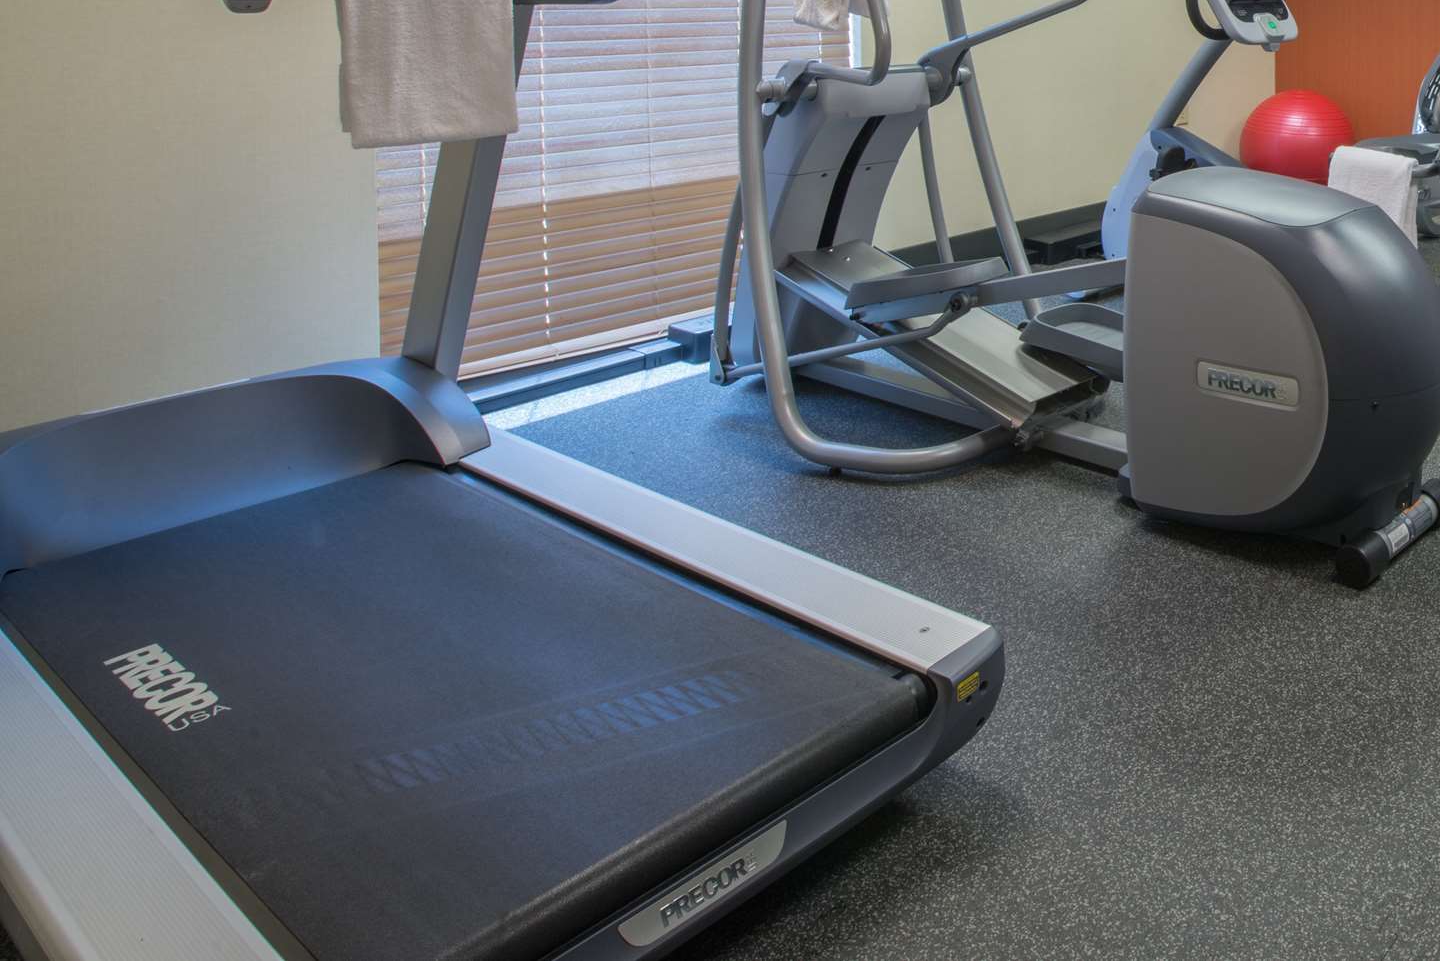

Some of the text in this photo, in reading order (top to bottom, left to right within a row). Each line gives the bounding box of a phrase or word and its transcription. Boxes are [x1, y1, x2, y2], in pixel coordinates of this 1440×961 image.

[1207, 367, 1278, 399] PRECOR
[103, 643, 219, 725] PRECOR
[167, 704, 232, 732] USA
[659, 858, 749, 929] PRECOR
